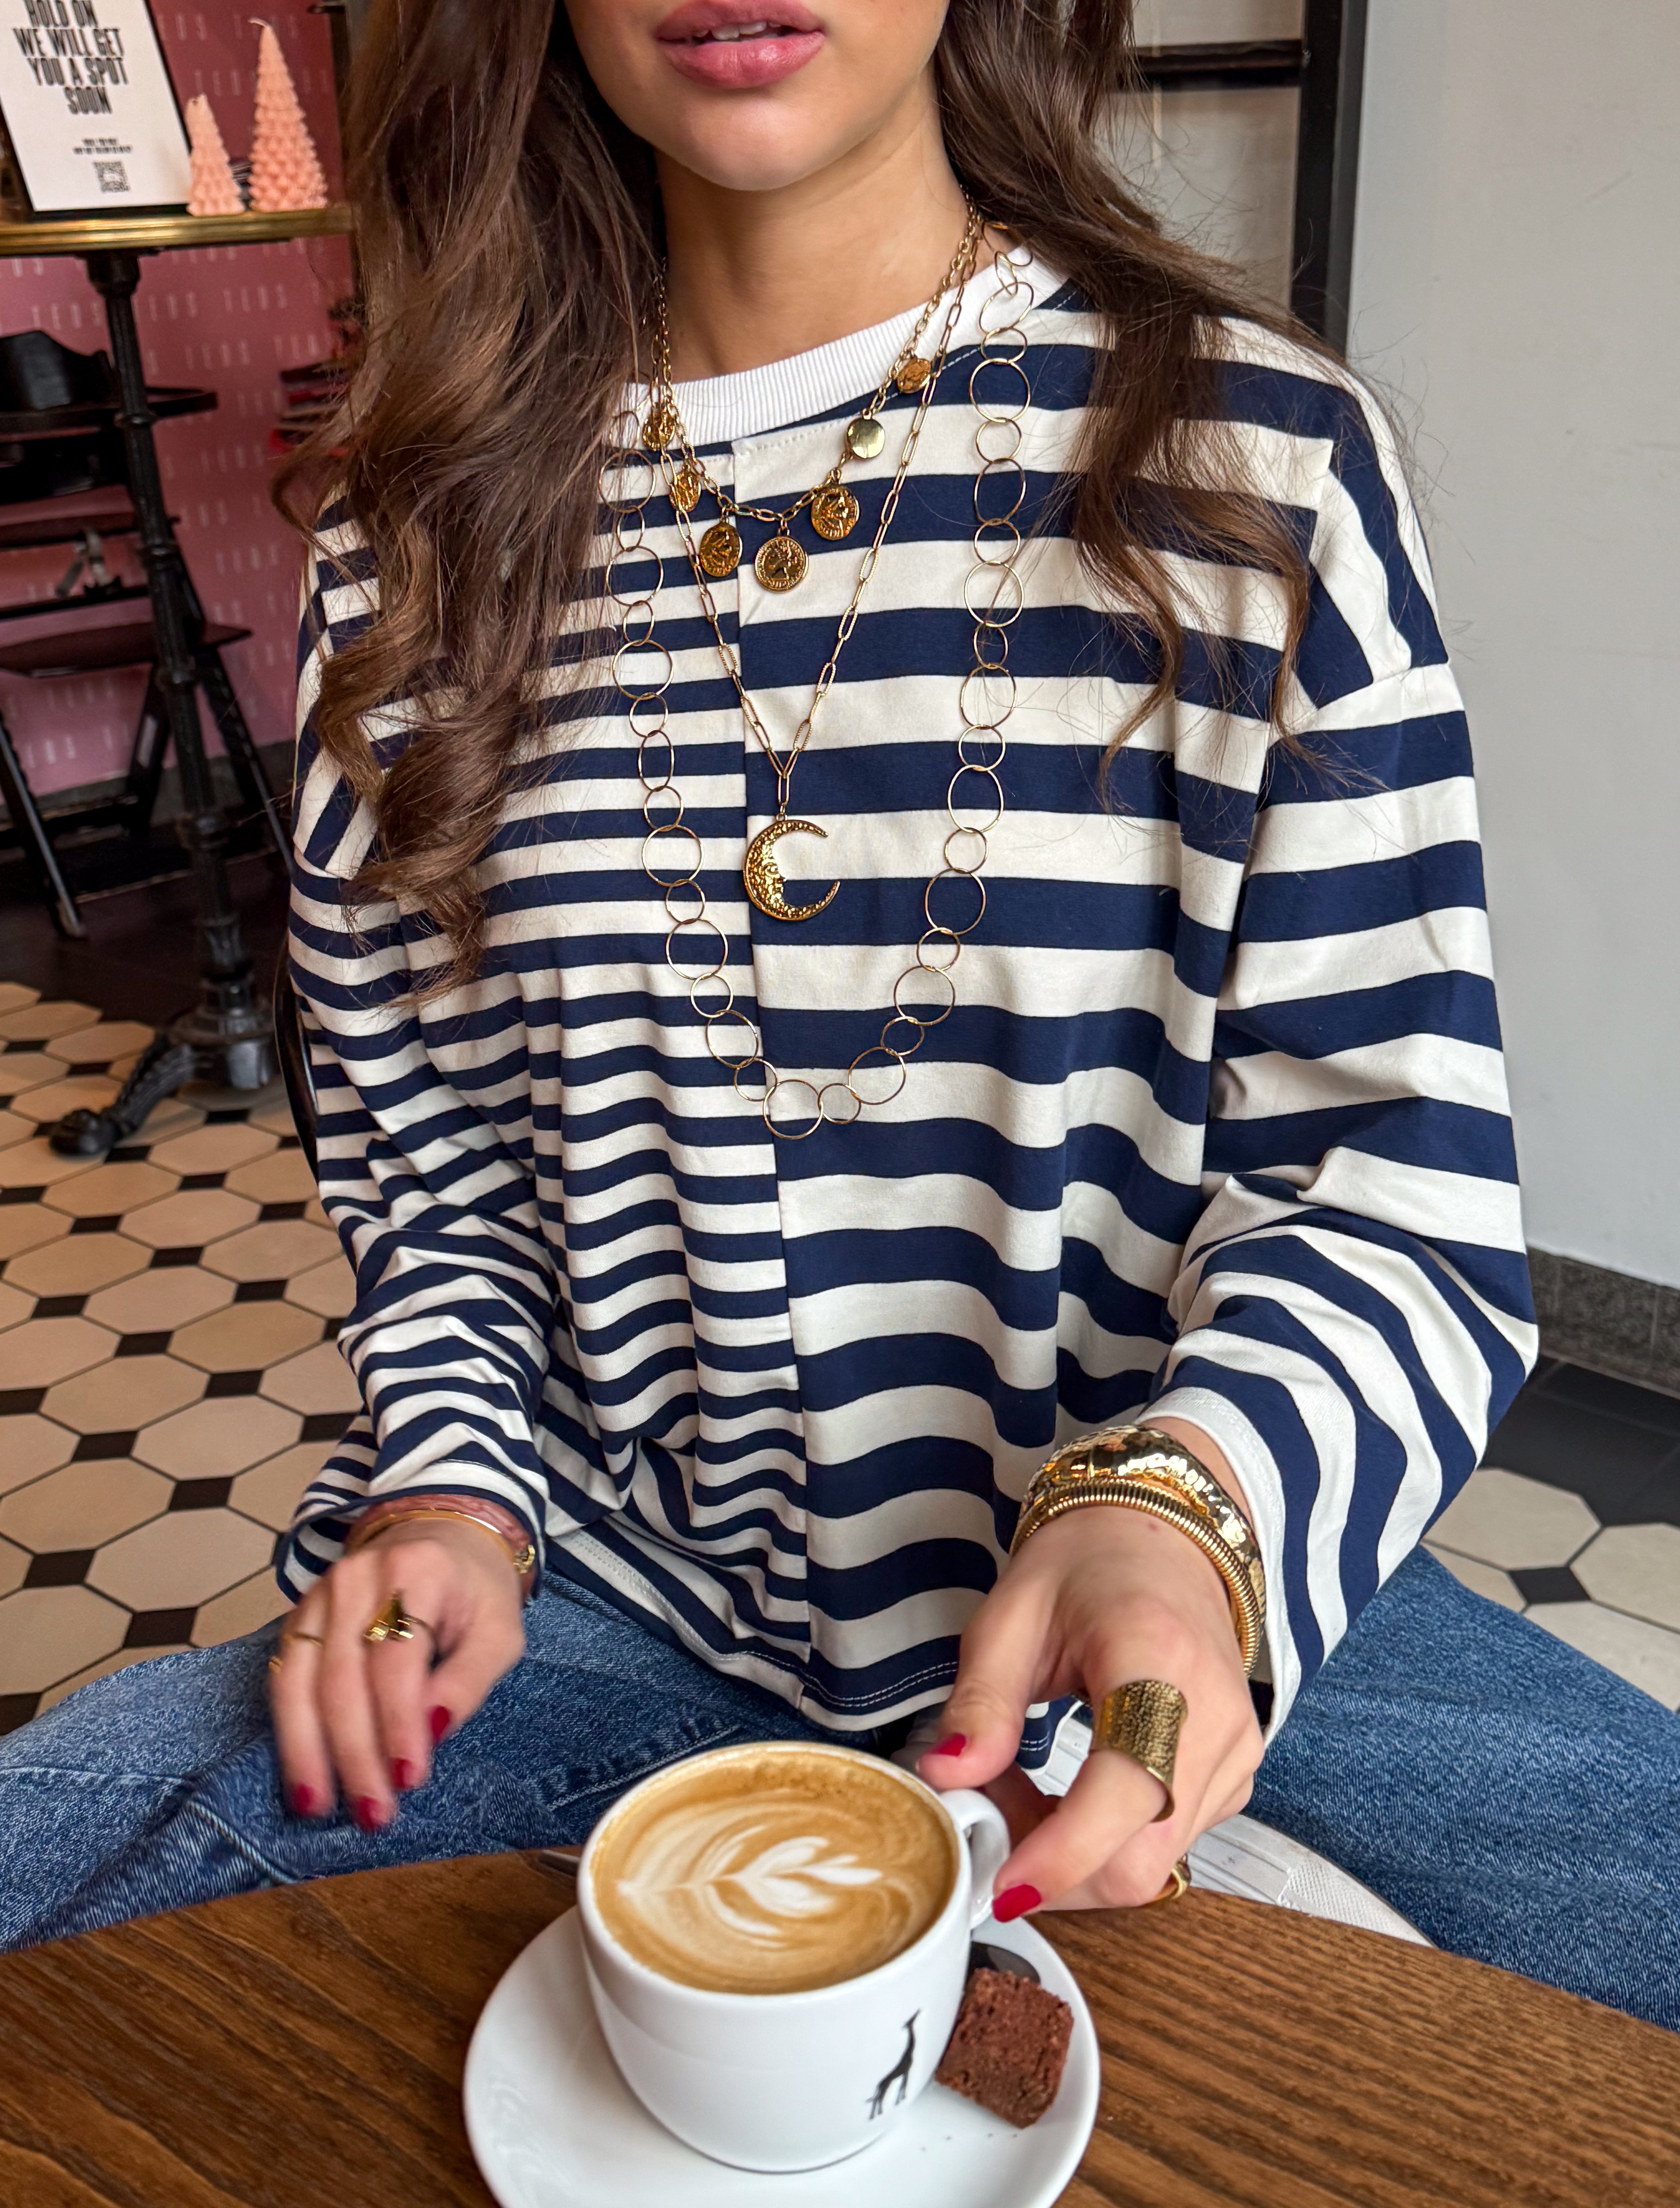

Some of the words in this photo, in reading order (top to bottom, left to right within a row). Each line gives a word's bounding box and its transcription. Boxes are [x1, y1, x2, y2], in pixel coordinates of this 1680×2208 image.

[23, 0, 70, 27] HOLD
[71, 0, 98, 27] ON
[12, 28, 45, 56] WE
[45, 28, 92, 56] WILL
[93, 28, 124, 56] GET
[26, 57, 65, 86] YOU
[69, 57, 84, 85] A
[84, 57, 129, 85] SPOT
[64, 86, 112, 115] SOON
